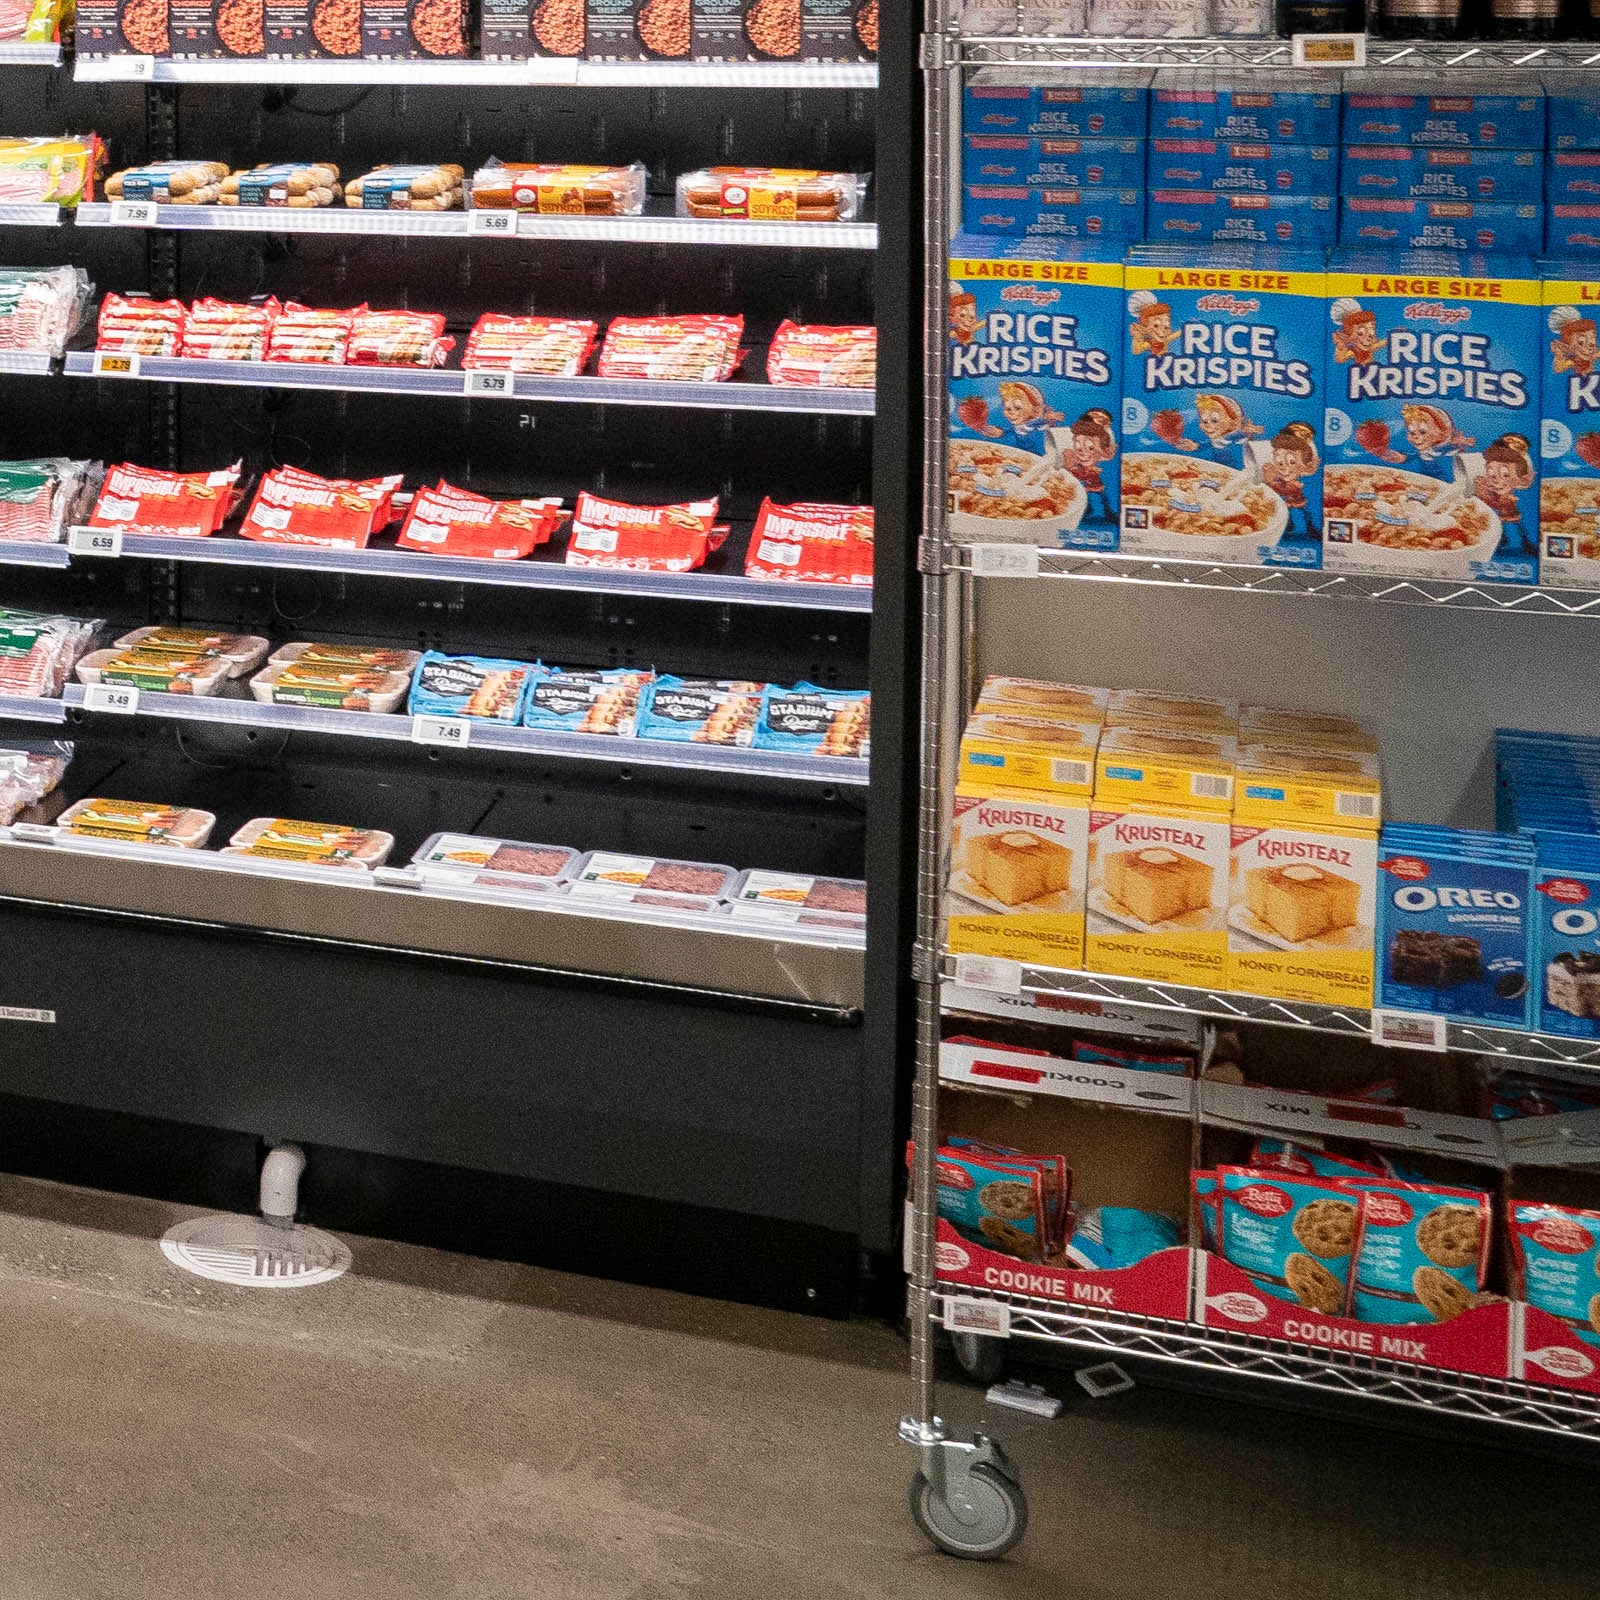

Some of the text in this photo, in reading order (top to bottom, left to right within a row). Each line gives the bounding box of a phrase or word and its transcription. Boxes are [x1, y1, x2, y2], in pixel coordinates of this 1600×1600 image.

[484, 0, 529, 8] GROUND
[588, 0, 634, 8] GROUND
[695, 0, 741, 8] GROUND
[804, 0, 850, 8] GROUND
[1039, 112, 1068, 123] RICE
[1227, 116, 1257, 128] RICE
[1424, 119, 1457, 133] RICE
[1038, 163, 1067, 175] RICE
[1225, 168, 1255, 180] RICE
[1422, 172, 1455, 185] RICE
[126, 208, 148, 219] 7.99
[1037, 214, 1066, 226] RICE
[485, 217, 508, 229] 5.69
[1225, 219, 1256, 232] RICE
[1422, 225, 1455, 238] RICE
[965, 263, 1089, 280] LARGE SIZE
[1159, 272, 1289, 290] LARGE SIZE
[1362, 278, 1503, 297] LARGE SIZE
[1000, 285, 1060, 306] Kellogg's
[1196, 294, 1260, 315] Kellogg's
[1403, 301, 1471, 323] Kellogg's
[989, 313, 1076, 347] RICE
[1183, 322, 1275, 358] RICE
[1389, 331, 1488, 368] RICE
[952, 345, 1111, 384] KRISPIES
[483, 378, 506, 390] 5.79
[1146, 357, 1312, 396] KRISPIES
[1349, 365, 1526, 407] KRISPIES
[1127, 406, 1136, 421] 8
[1328, 417, 1340, 432] 8
[1548, 429, 1560, 444] 8
[110, 470, 184, 498] IMPOSSIBLE
[262, 477, 338, 508] IMPOSSIBLE
[414, 498, 494, 525] IMPOSSIBLE
[581, 497, 666, 526] IMPOSSIBLE
[764, 513, 852, 542] IMPOSSIBLE
[91, 536, 114, 549] 6.59
[422, 665, 484, 687] STADIUM
[107, 693, 130, 706] 9.49
[535, 687, 597, 704] STADIUM
[655, 692, 717, 712] STADIUM
[769, 702, 835, 720] STADIUM
[438, 725, 461, 739] 7.49
[978, 807, 1066, 834] KRUSTEAZ
[1114, 823, 1206, 850] KRUSTEAZ
[1256, 838, 1353, 867] KRUSTEAZ
[1392, 885, 1521, 913] OREO
[958, 921, 1080, 945] HONEY CORNBREAD
[1096, 940, 1141, 955] HONEY
[1143, 945, 1224, 966] CORNBREAD
[1238, 957, 1284, 974] HONEY
[1287, 963, 1370, 985] CORNBREAD
[1040, 1071, 1126, 1089] COOKI
[1263, 1101, 1311, 1115] MIX
[1245, 1187, 1282, 1204] Betty
[984, 1266, 1115, 1304] COOKIE MIX
[1283, 1319, 1427, 1361] COOKIE MIX
